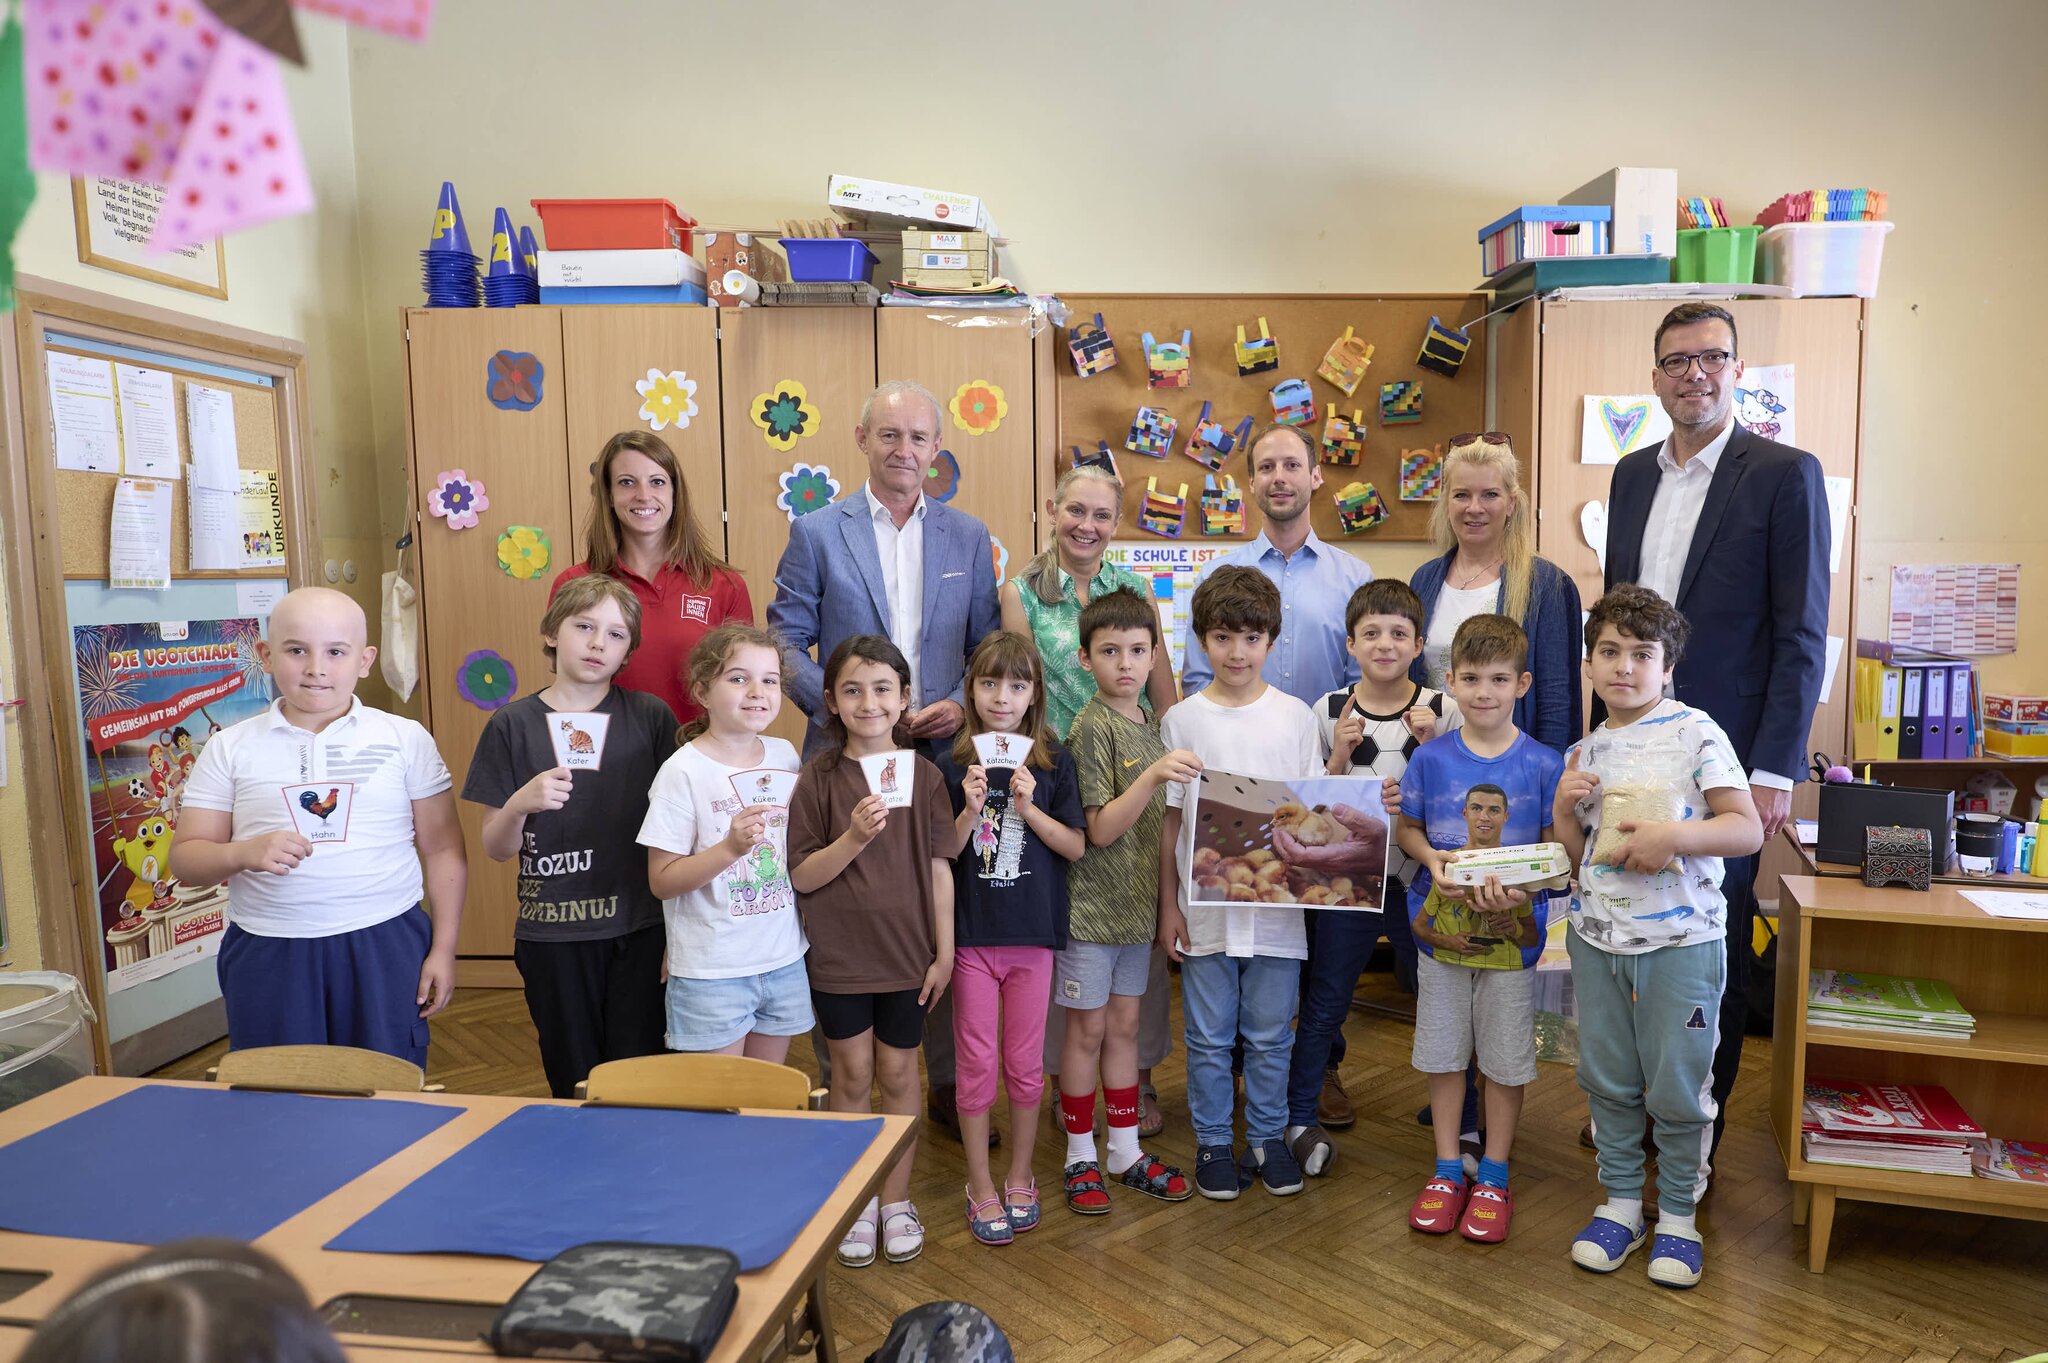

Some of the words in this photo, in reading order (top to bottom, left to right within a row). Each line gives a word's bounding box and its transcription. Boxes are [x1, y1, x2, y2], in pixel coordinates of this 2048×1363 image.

[98, 175, 116, 188] Land
[118, 182, 130, 192] der
[97, 185, 116, 200] Land
[117, 193, 130, 204] der
[843, 191, 863, 199] MFT
[922, 191, 972, 207] CHALLENGE
[105, 200, 131, 217] Heimat
[132, 208, 146, 222] bist
[146, 214, 156, 224] du
[951, 204, 970, 215] DISC
[432, 209, 457, 240] P
[491, 233, 513, 264] 2
[936, 235, 956, 244] MAX
[268, 471, 285, 553] URKUNDE
[1104, 550, 1128, 562] DIE
[1133, 549, 1188, 562] SCHULE
[1192, 549, 1215, 562] IST
[686, 608, 705, 618] INNEN
[108, 650, 140, 671] DIE
[144, 643, 239, 667] UGOTCHIADE
[100, 713, 149, 739] GEMEINSAM
[150, 709, 164, 721] MIT
[165, 706, 178, 719] DEN
[566, 757, 589, 765] Kater
[986, 757, 1018, 766] Kätzchen
[311, 831, 336, 839] Hahn
[730, 885, 757, 902] TO
[762, 878, 787, 899] STA
[518, 896, 618, 923] OMBINUJ
[730, 889, 793, 916] GROOVY
[174, 910, 223, 934] UGOTCHI
[1685, 1006, 1708, 1030] A
